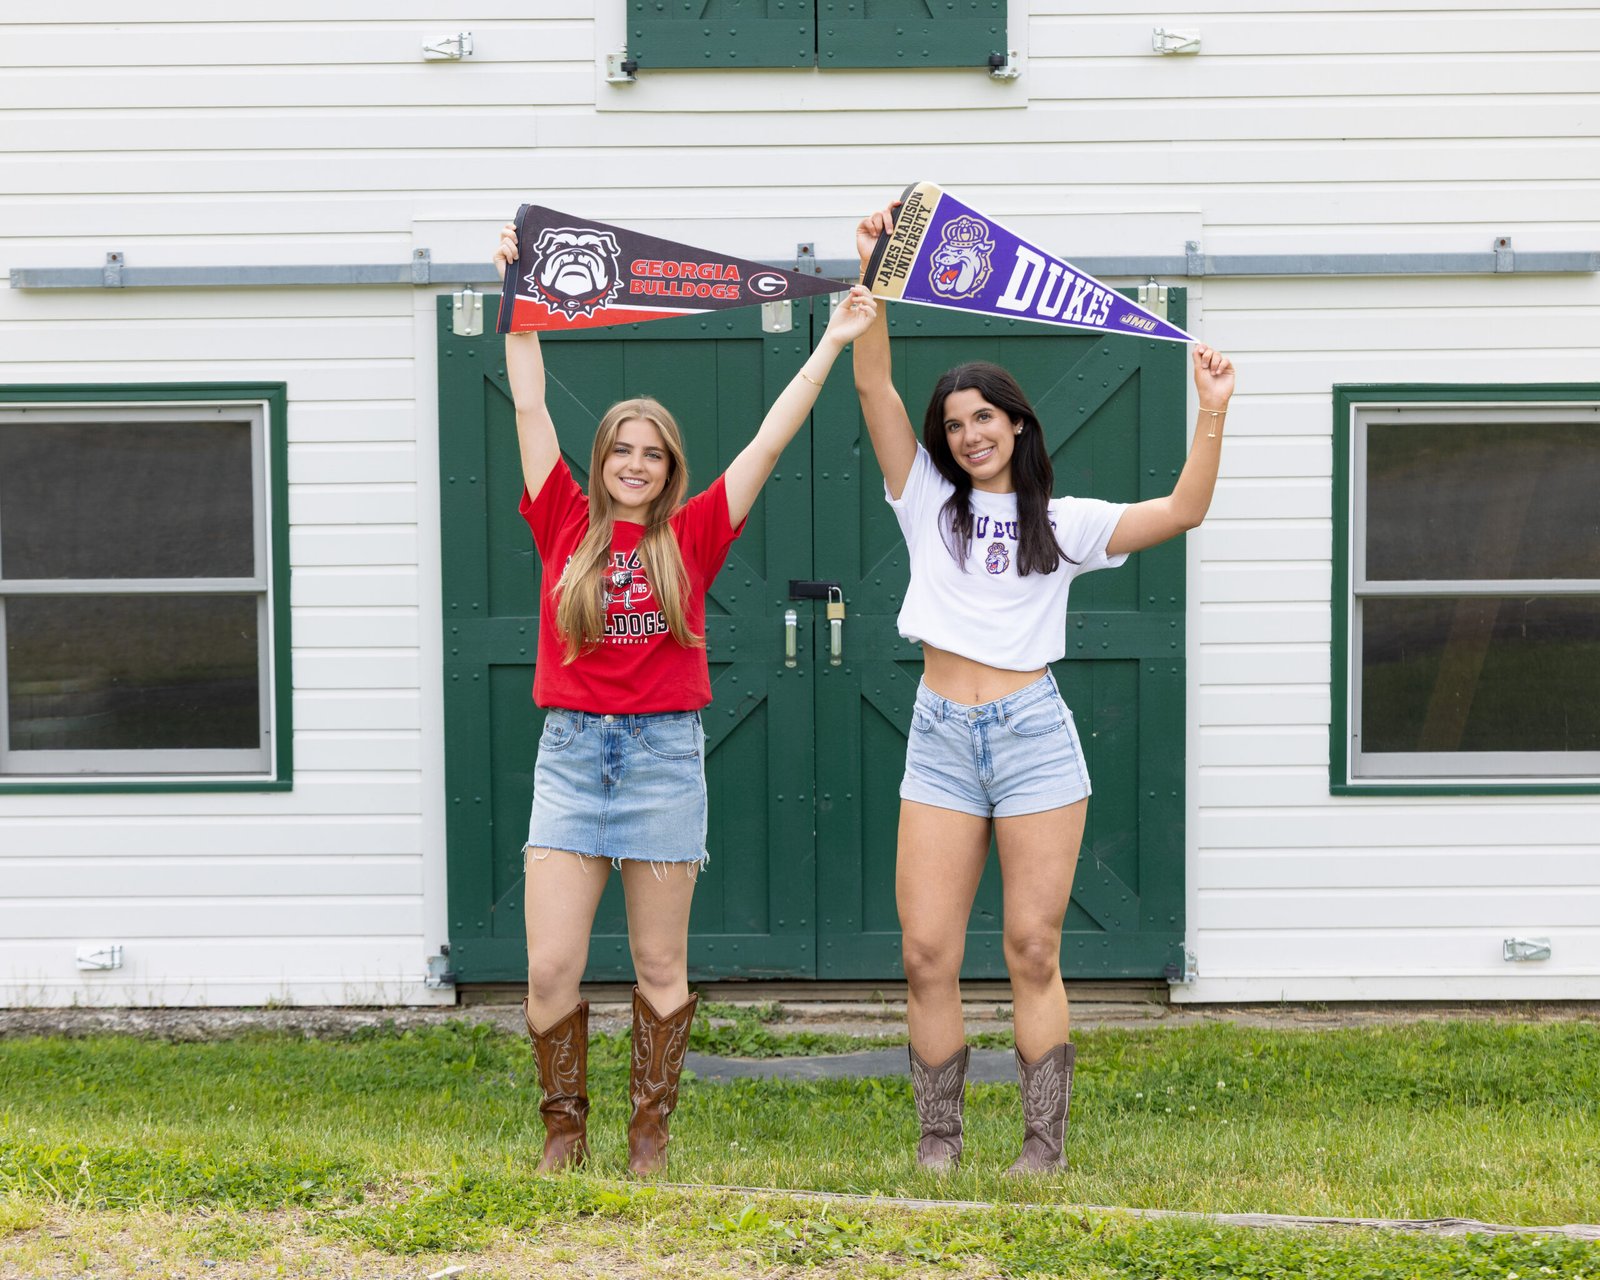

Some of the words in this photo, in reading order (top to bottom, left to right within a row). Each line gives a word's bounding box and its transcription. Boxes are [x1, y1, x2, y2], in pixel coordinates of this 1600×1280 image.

[877, 244, 902, 287] JAMES
[893, 191, 924, 243] MADISON
[893, 204, 932, 279] UNIVERSITY
[630, 259, 741, 281] GEORGIA
[629, 279, 740, 300] BULLDOGS
[996, 244, 1114, 326] DUKES
[1120, 313, 1158, 332] JMU
[632, 583, 647, 593] 1785
